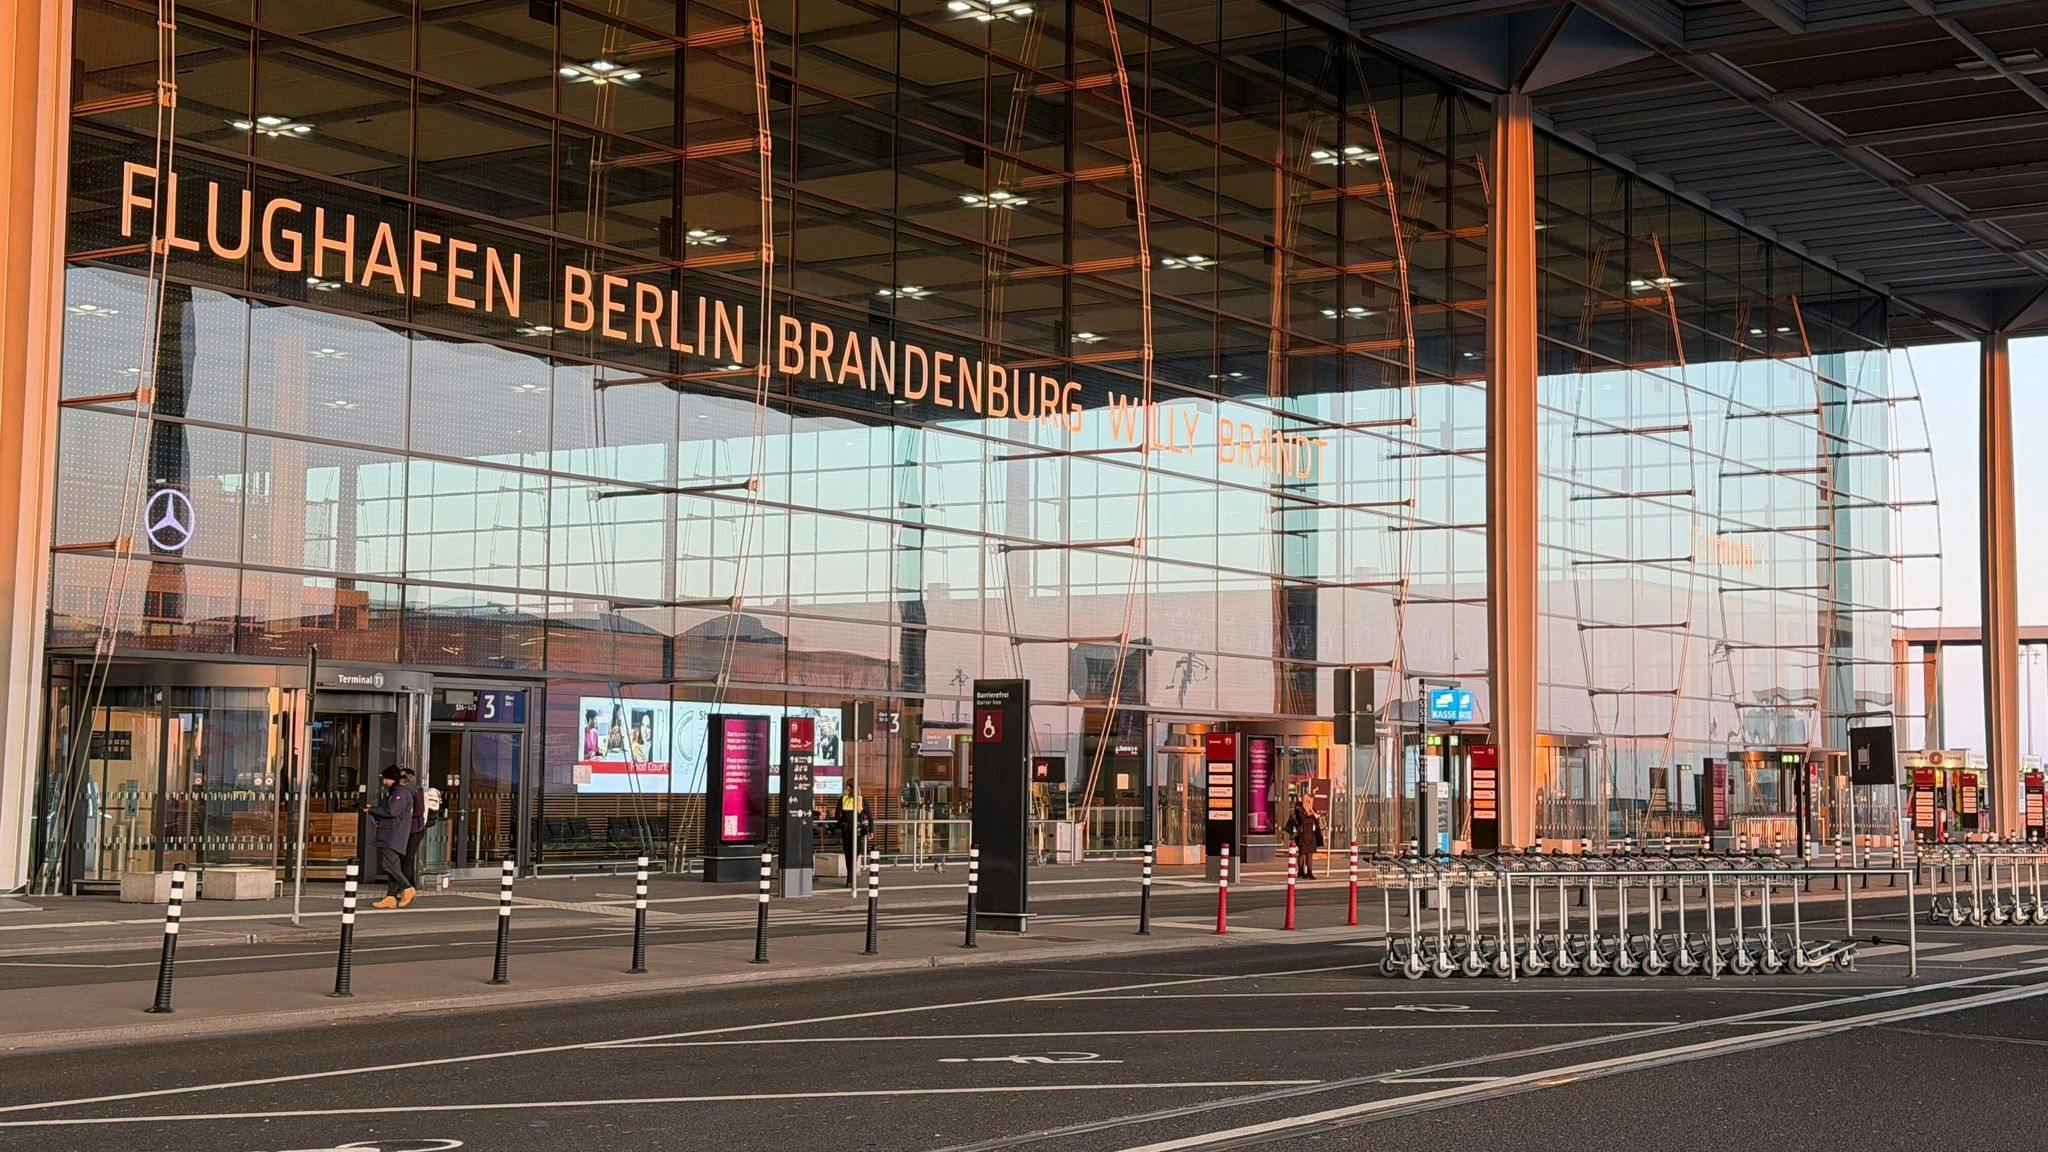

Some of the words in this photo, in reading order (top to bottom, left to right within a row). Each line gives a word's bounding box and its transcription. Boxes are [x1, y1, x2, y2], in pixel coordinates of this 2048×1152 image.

[121, 160, 521, 318] FLUGHAFEN
[563, 265, 744, 364] BERLIN
[777, 315, 1083, 433] BRANDENBURG
[1108, 391, 1200, 455] WILLY
[1217, 418, 1329, 481] BRANDT
[338, 674, 373, 685] Terminal
[976, 691, 1009, 699] Barrierefrei
[483, 694, 496, 719] 3
[1431, 710, 1458, 720] KASSE
[889, 713, 900, 733] 3
[917, 742, 923, 755] 2
[946, 735, 952, 750] 1
[648, 762, 669, 772] Court
